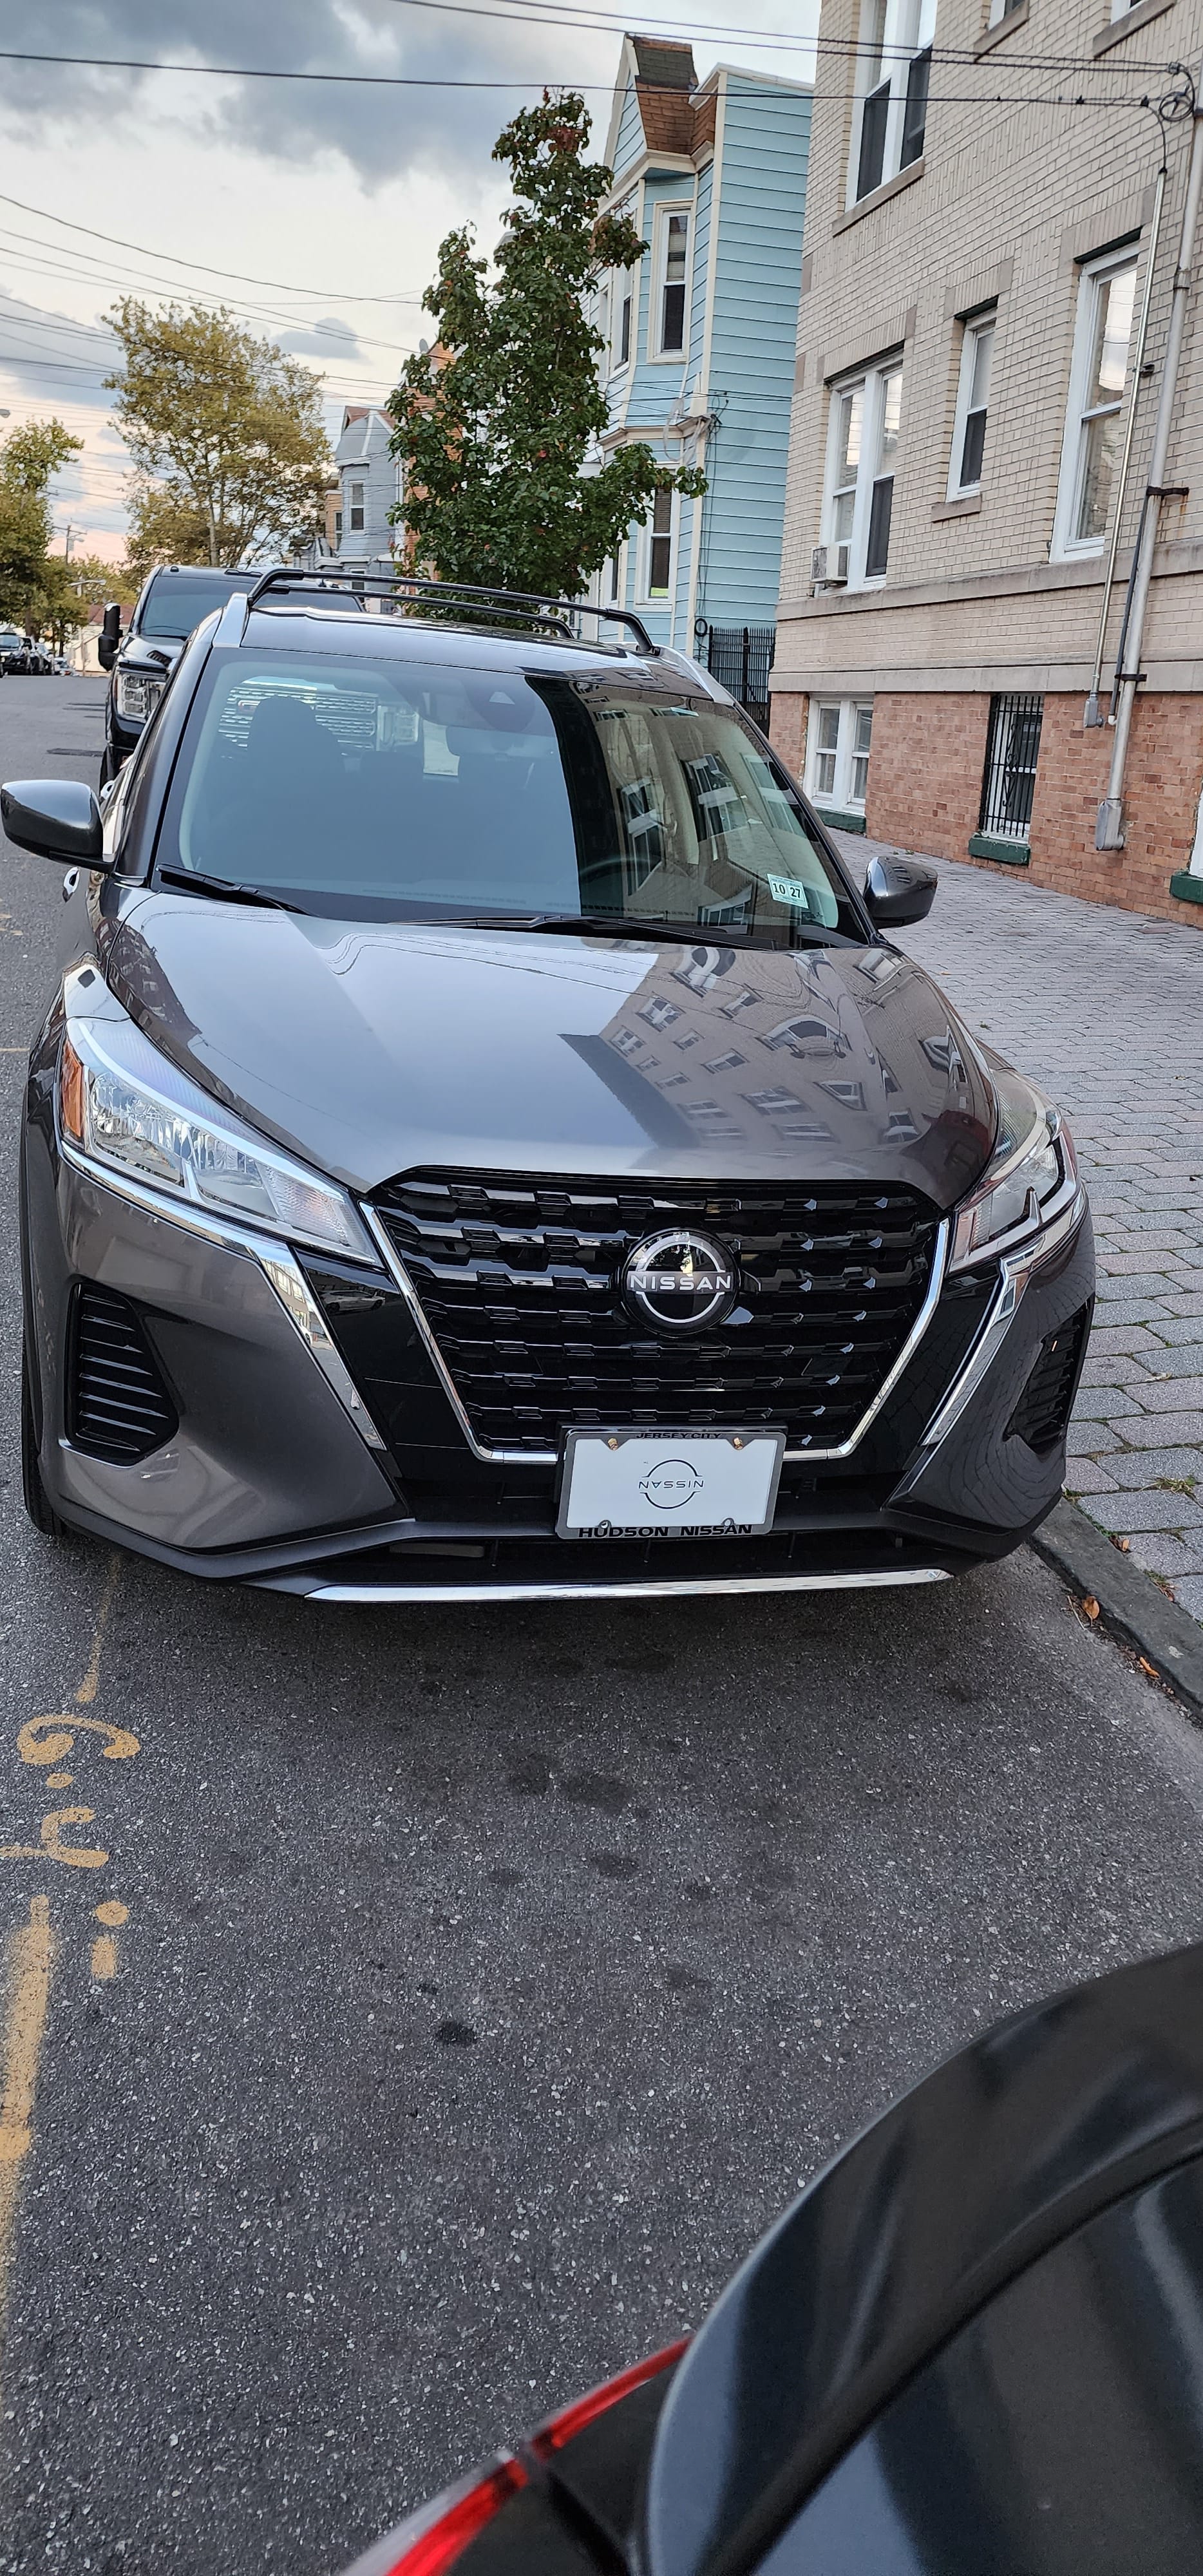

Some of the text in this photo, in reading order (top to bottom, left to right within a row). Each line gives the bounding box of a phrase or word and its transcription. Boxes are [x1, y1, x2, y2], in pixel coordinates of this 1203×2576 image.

[773, 883, 800, 898] 10 27
[630, 1275, 731, 1291] NISSAN
[638, 1480, 705, 1490] NISSAN
[578, 1524, 753, 1538] HUDSON NISSAN
